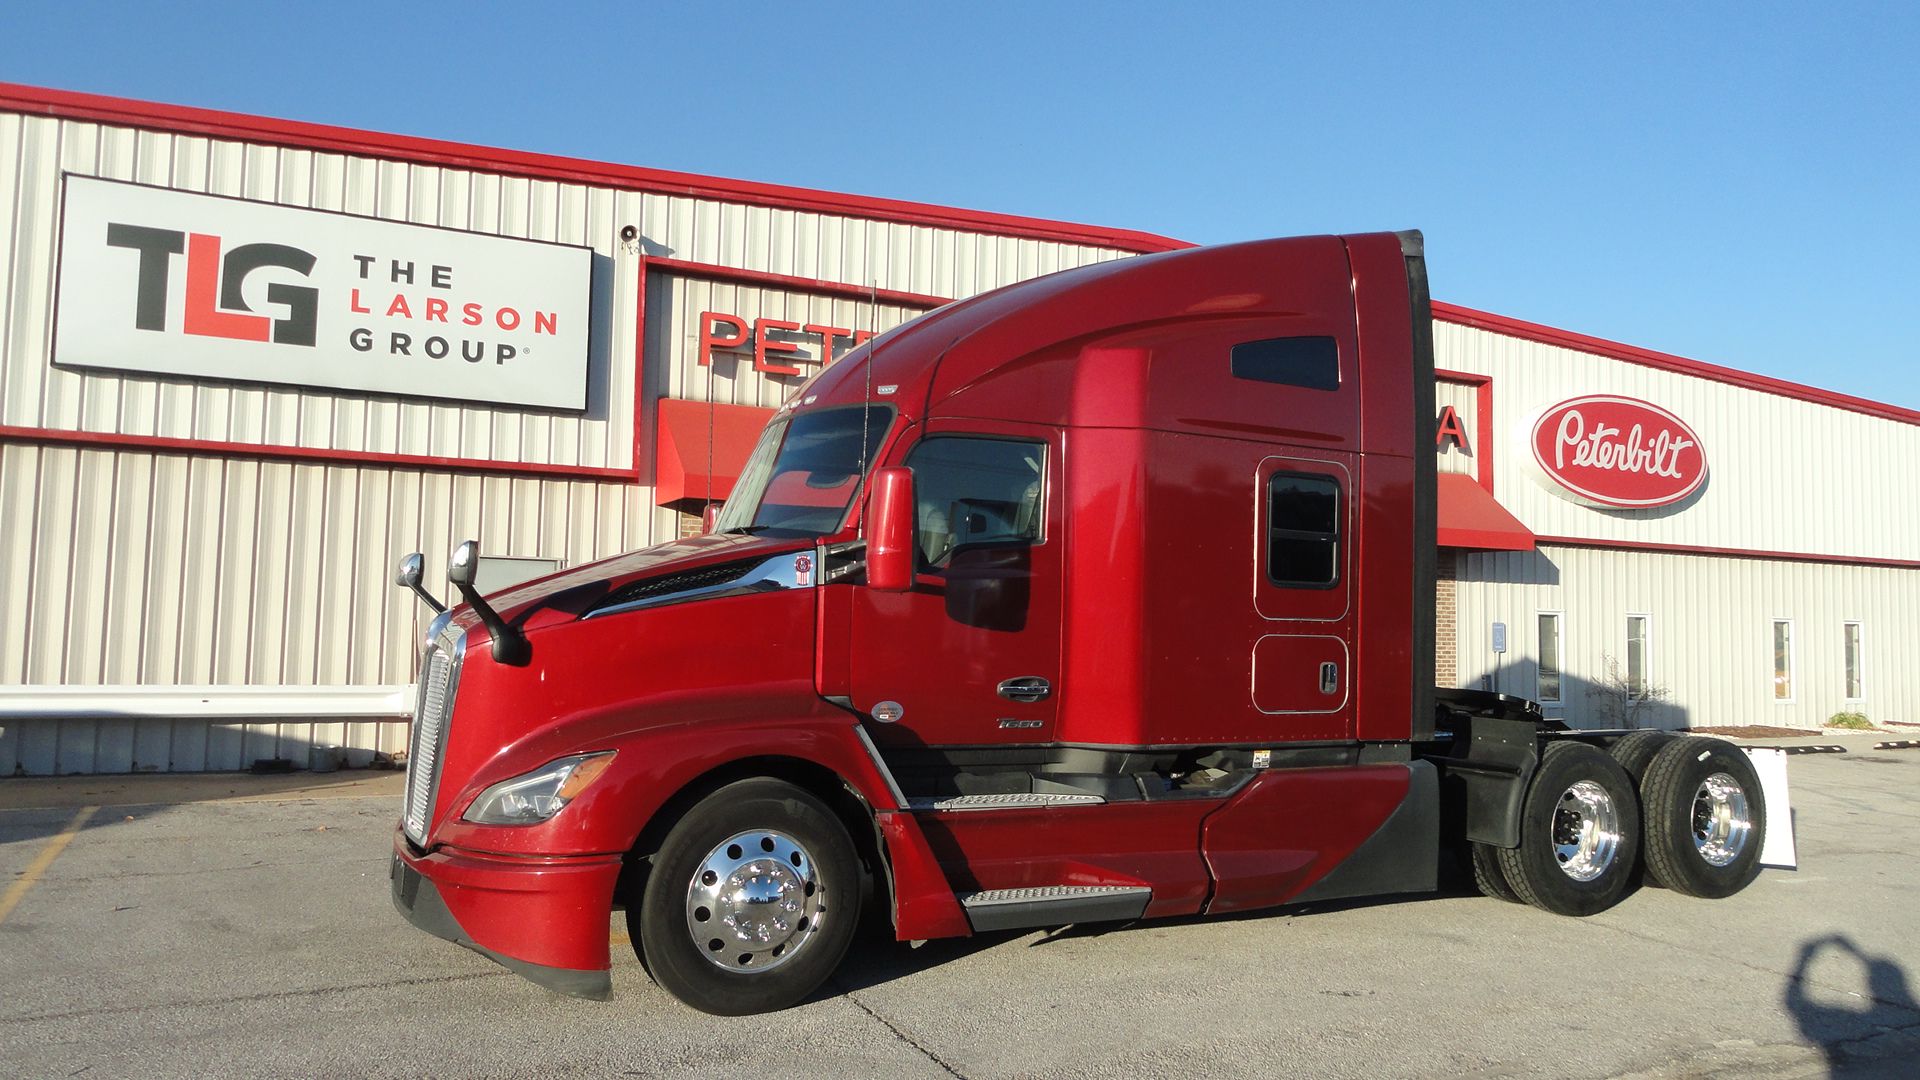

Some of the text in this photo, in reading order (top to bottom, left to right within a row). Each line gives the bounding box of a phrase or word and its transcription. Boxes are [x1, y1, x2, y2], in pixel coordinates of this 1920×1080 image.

[106, 222, 319, 347] TLG
[353, 254, 453, 289] THE
[351, 288, 557, 335] LARSON
[1555, 410, 1694, 479] Peterbilt
